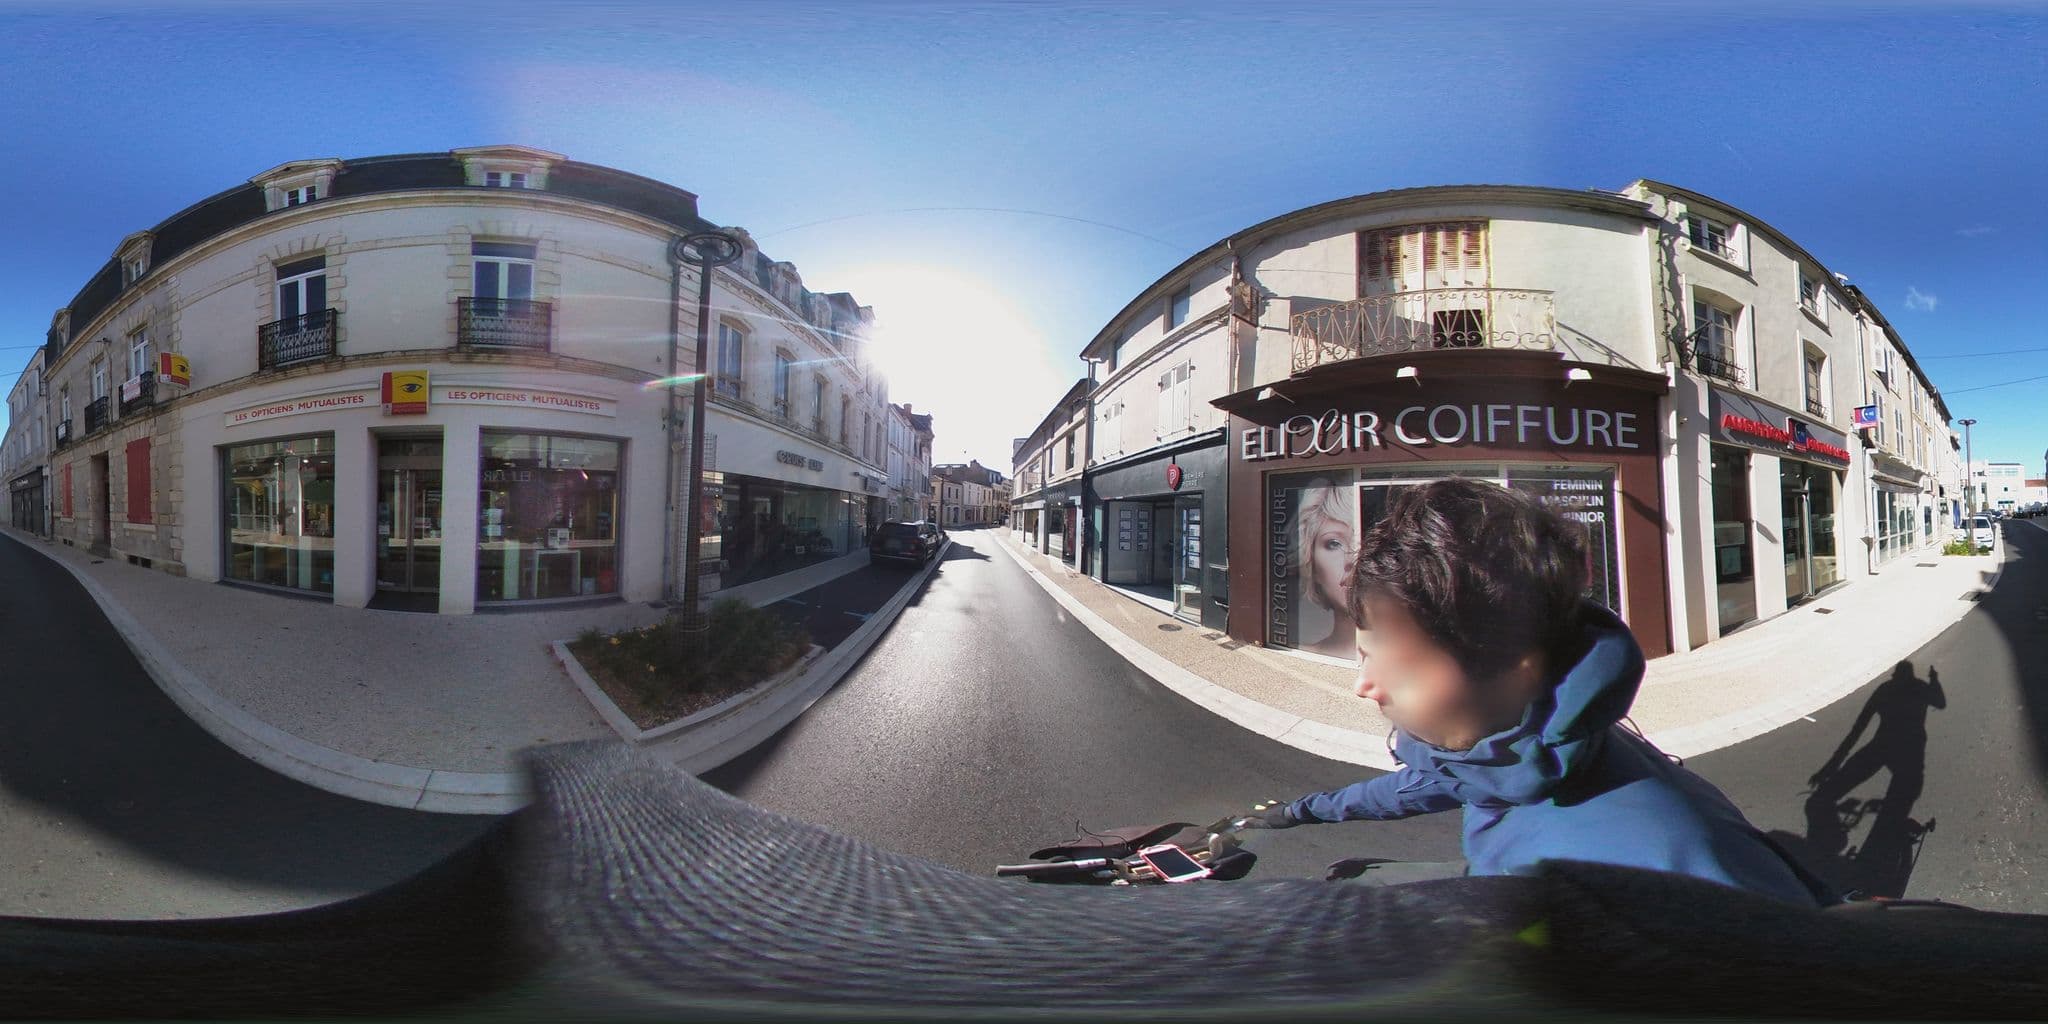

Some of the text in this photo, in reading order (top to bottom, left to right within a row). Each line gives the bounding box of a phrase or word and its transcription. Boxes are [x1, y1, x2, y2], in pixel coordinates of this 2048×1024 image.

[235, 395, 364, 421] LES OPTICIENS MUTUALISTES
[448, 391, 600, 411] LES OPTICIENS MUTUALISTES
[1242, 404, 1639, 459] ELIXIR COIFFURE
[1553, 480, 1603, 490] FEMININ
[1562, 512, 1605, 523] UNIOR
[1273, 488, 1287, 577] COIFFURE
[1273, 583, 1288, 645] ELIXIR
